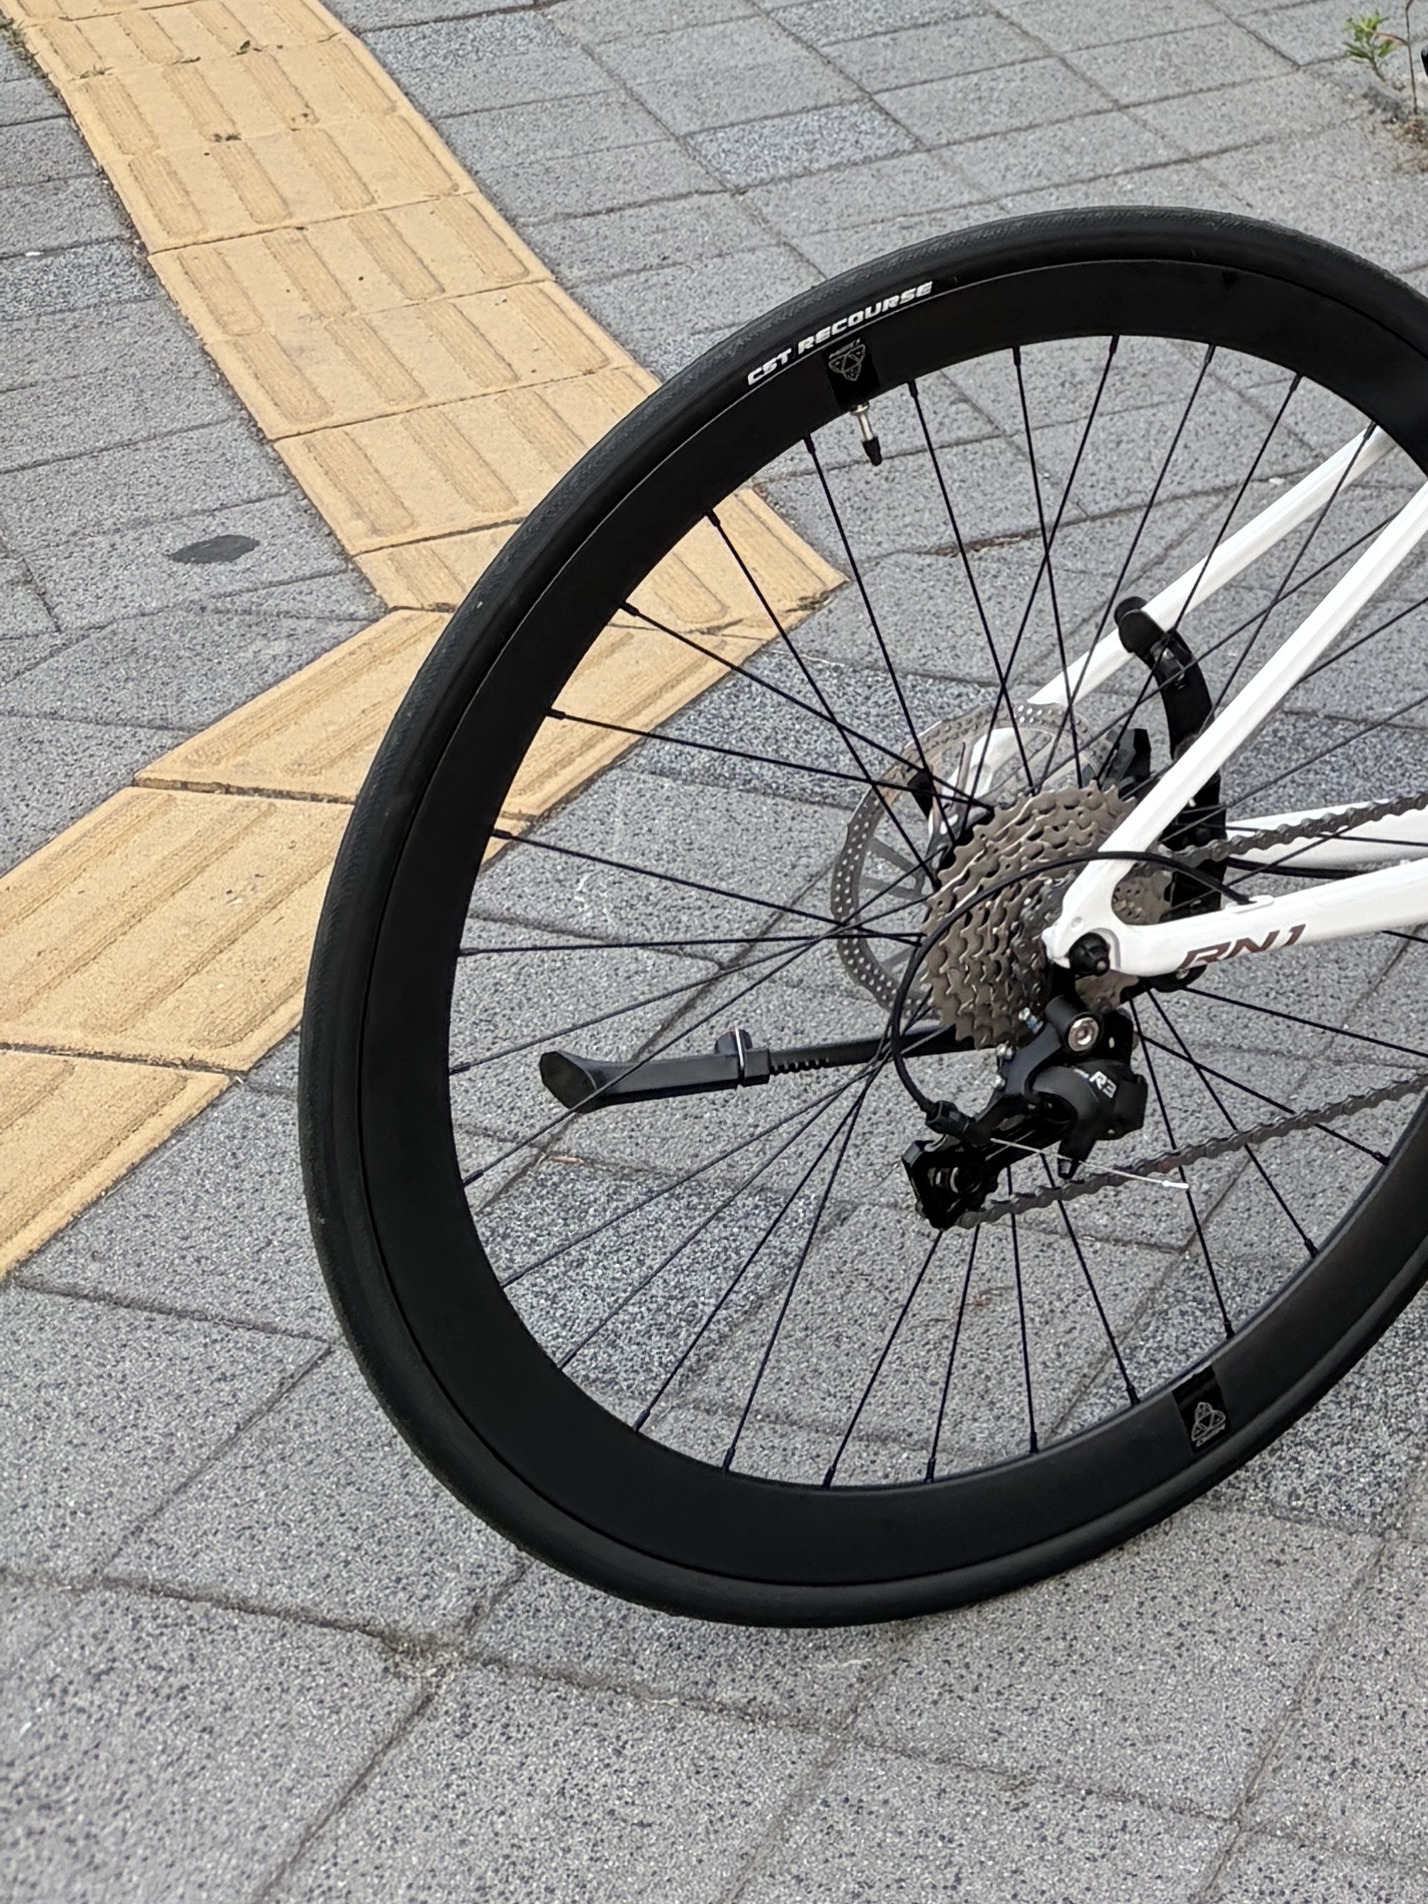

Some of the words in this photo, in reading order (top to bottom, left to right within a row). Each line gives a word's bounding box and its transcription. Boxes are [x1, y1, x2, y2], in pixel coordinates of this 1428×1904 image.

[747, 349, 793, 386] CST
[799, 282, 934, 354] RECOURSE
[1180, 923, 1307, 970] RN1
[1089, 1071, 1118, 1099] R3
